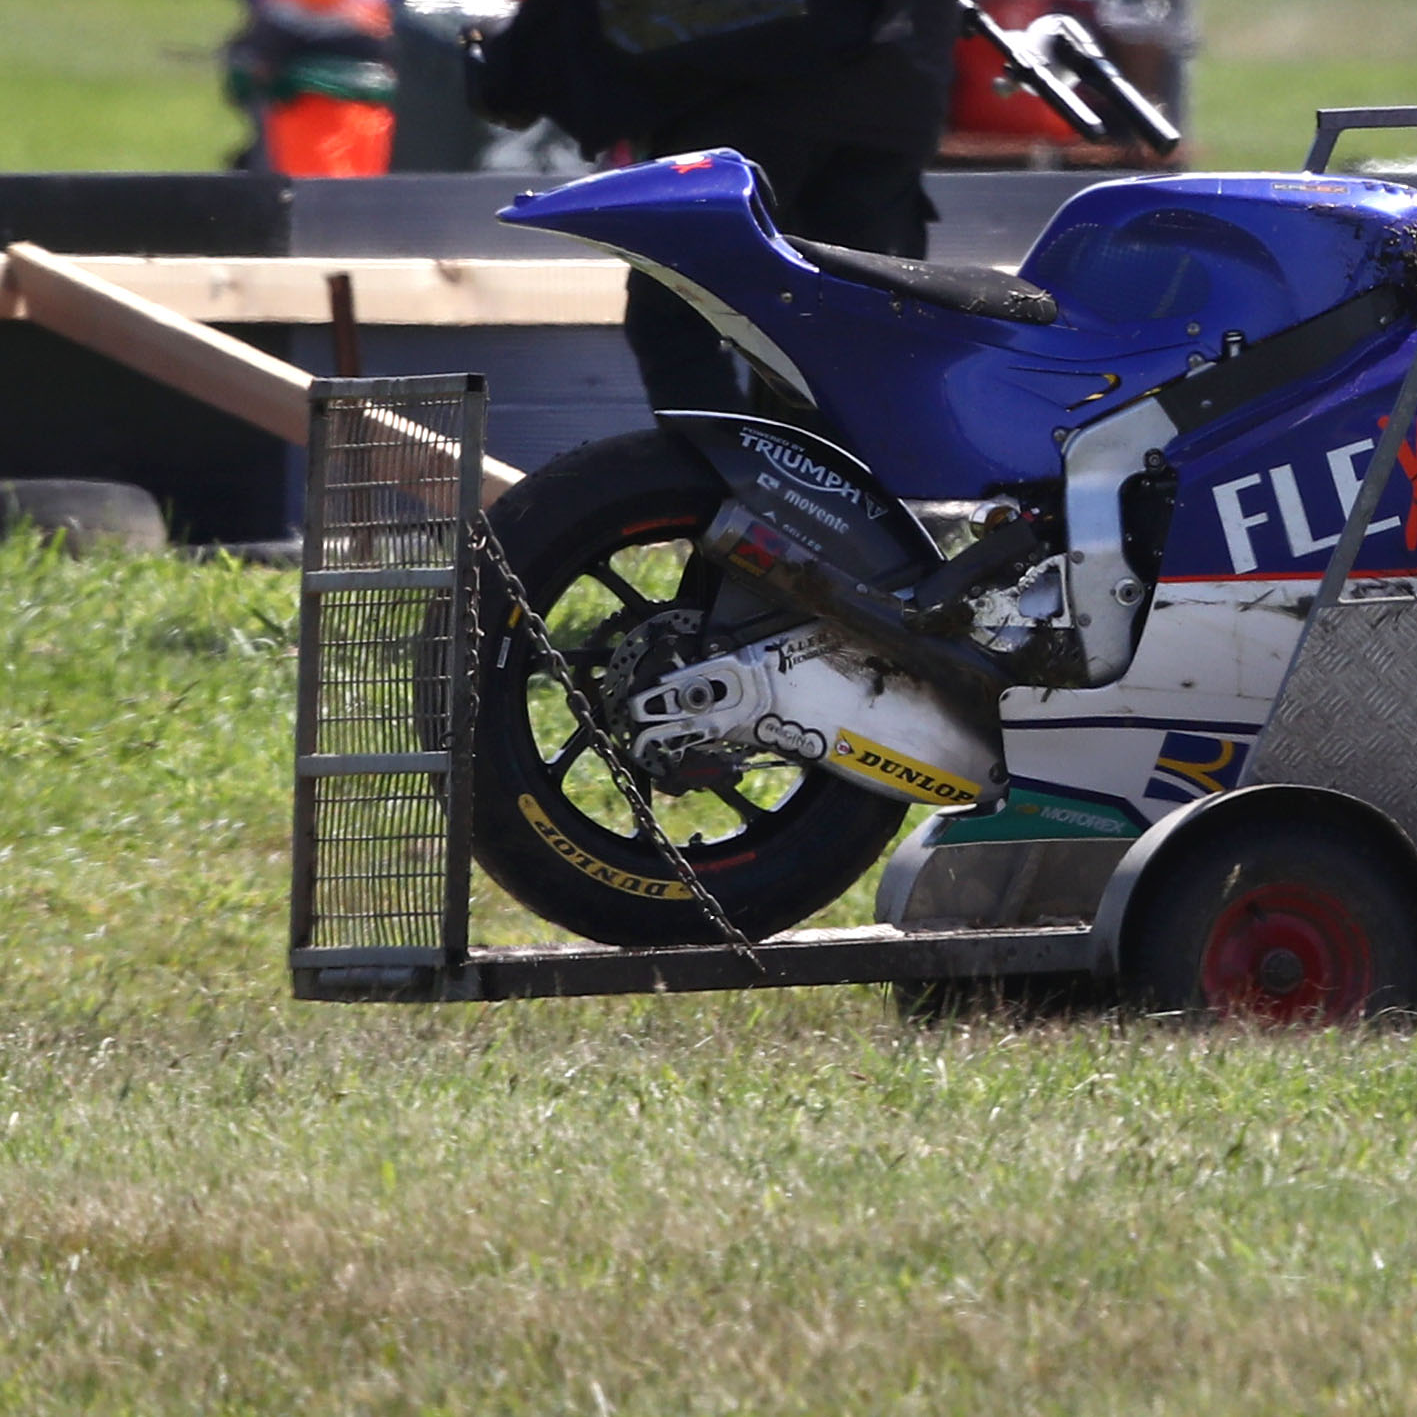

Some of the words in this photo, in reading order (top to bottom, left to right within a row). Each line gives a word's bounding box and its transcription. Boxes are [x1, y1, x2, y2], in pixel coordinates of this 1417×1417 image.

[739, 432, 861, 504] TRIUMPH
[855, 749, 977, 804] DUNLOP
[1039, 805, 1128, 834] MOTOREX
[534, 820, 671, 897] DUNLOP
